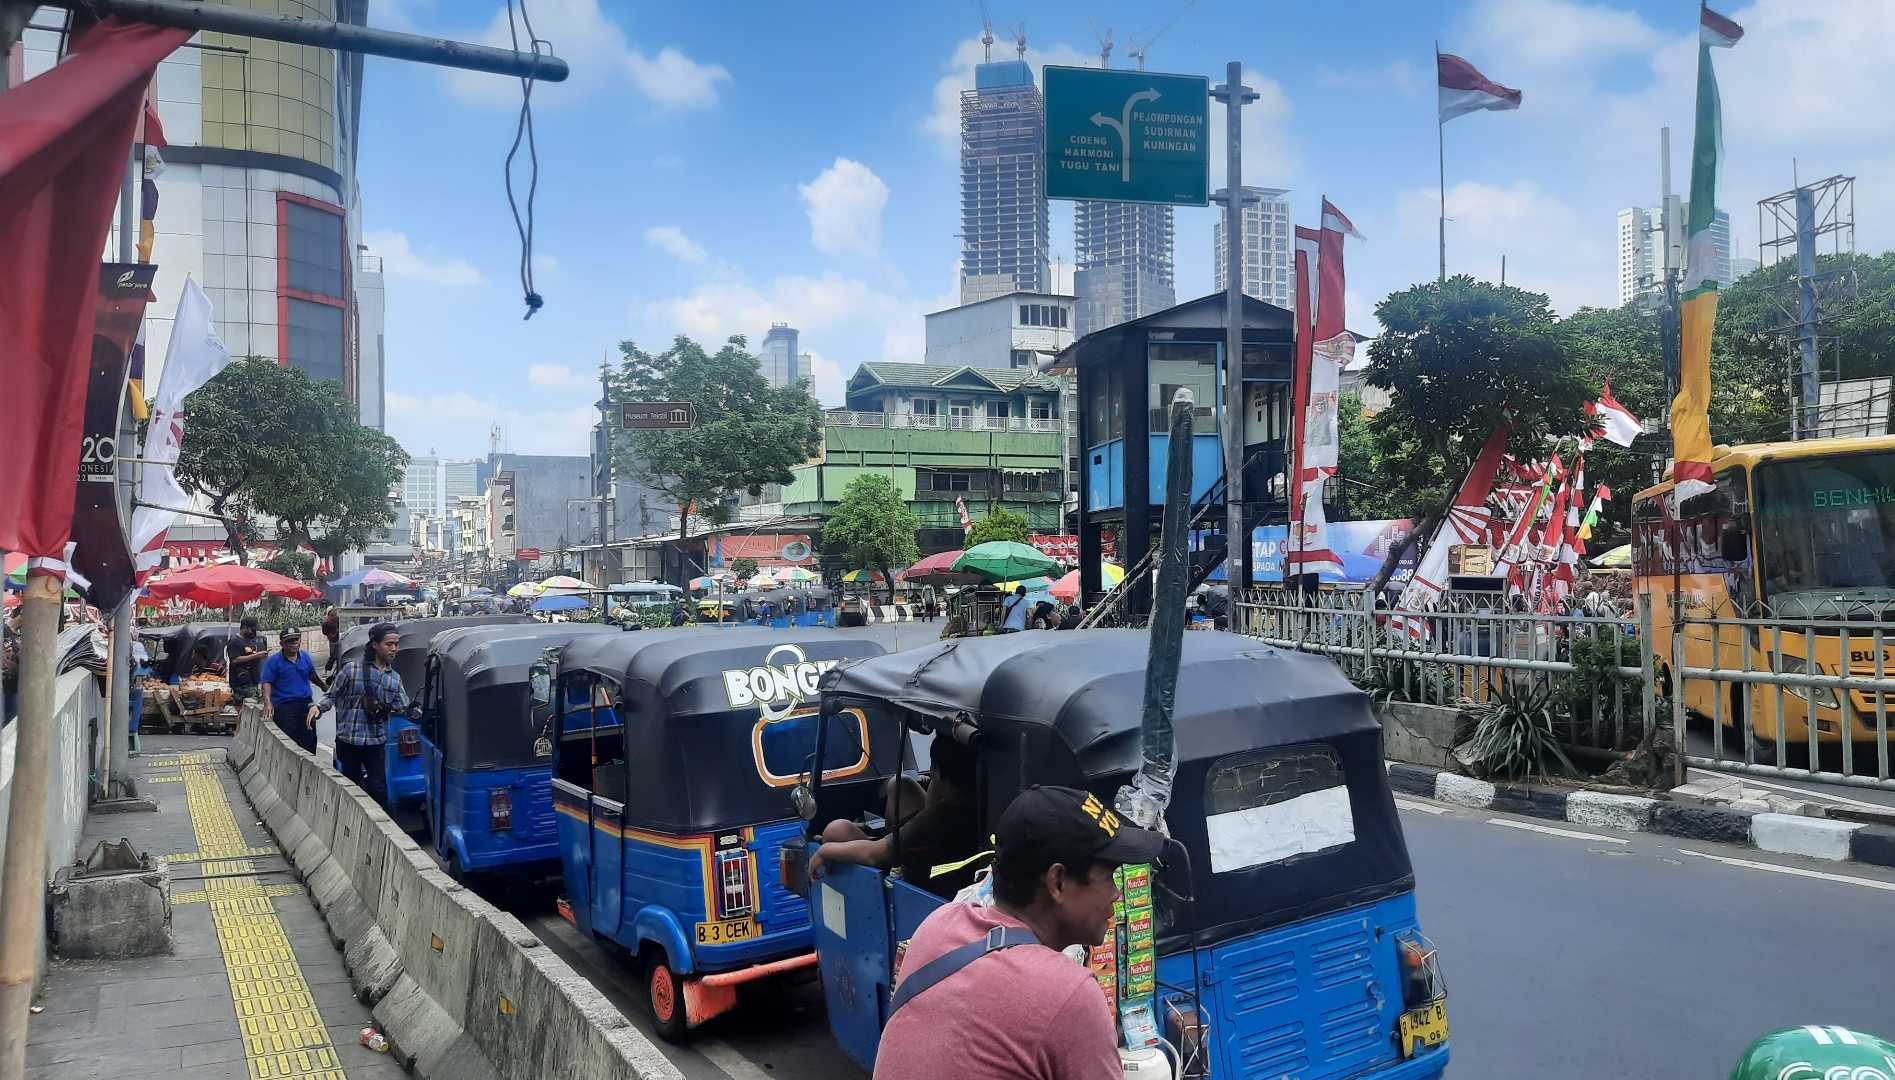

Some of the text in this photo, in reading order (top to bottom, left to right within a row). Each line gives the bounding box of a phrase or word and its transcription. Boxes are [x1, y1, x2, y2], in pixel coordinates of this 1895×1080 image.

[1134, 112, 1203, 125] PEJOMPONGAN
[1144, 126, 1196, 138] SUDIRMAN
[1070, 135, 1108, 145] CIDENG
[1143, 140, 1196, 152] KUNINGAN
[1064, 148, 1114, 158] HARMONI
[1060, 160, 1120, 172] TUGU TANI
[625, 412, 648, 420] Museum
[1252, 541, 1276, 559] TAP
[1850, 650, 1890, 662] BUS
[698, 921, 750, 942] B 3 CEK
